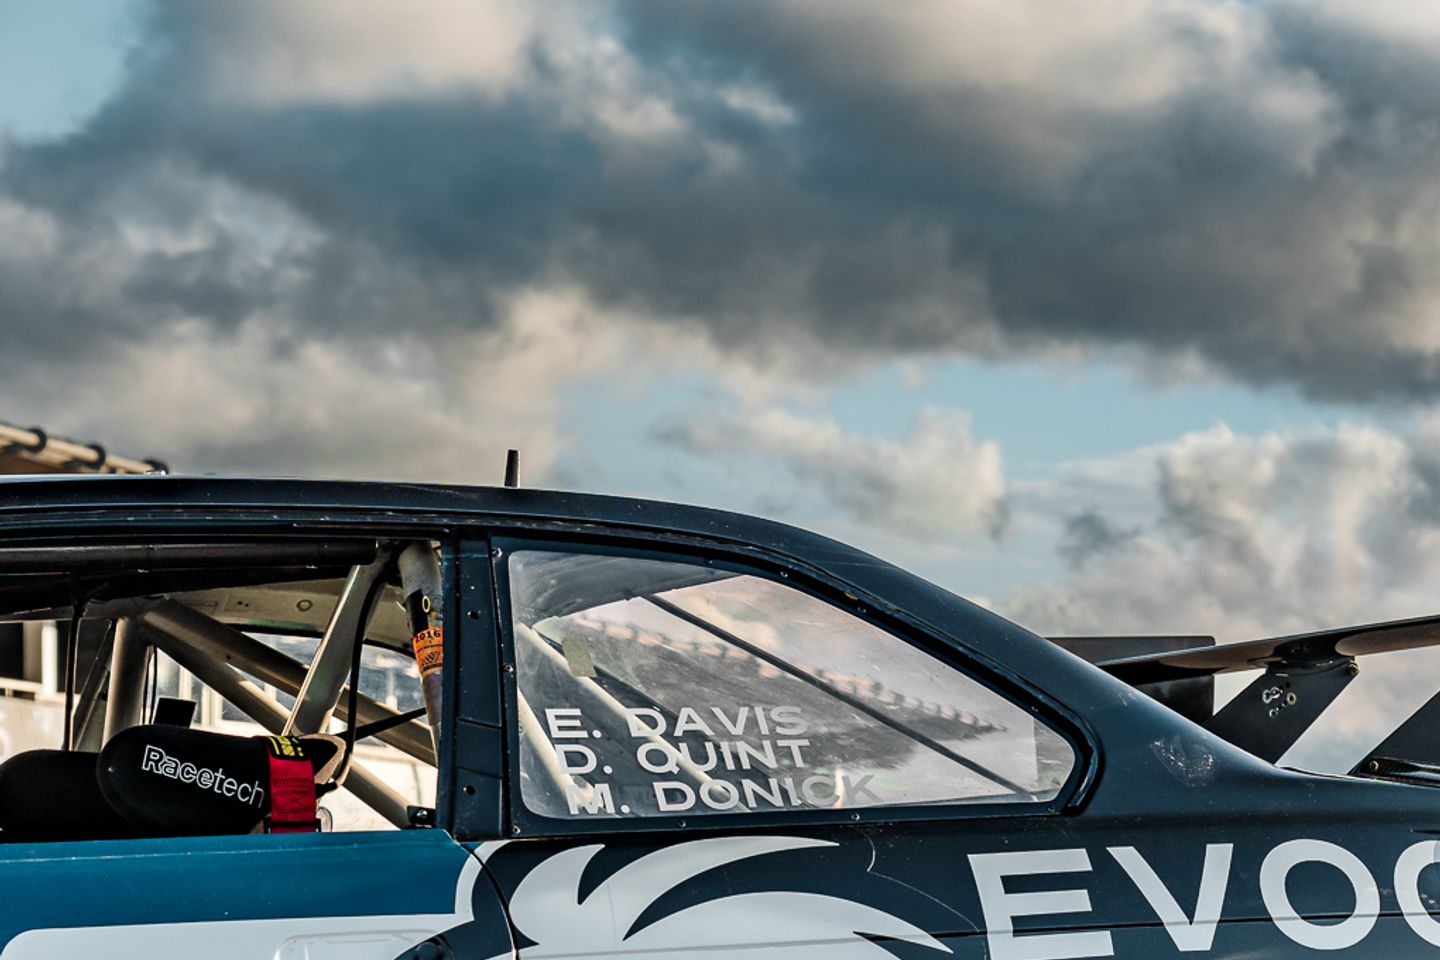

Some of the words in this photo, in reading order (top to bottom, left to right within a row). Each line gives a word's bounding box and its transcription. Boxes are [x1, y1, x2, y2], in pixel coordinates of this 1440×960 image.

[544, 707, 602, 739] E.
[624, 705, 811, 738] DAVIS
[142, 744, 266, 810] Racetech
[554, 743, 613, 775] D.
[636, 739, 811, 776] QUINT
[565, 783, 631, 815] M.
[652, 774, 883, 813] DONICK
